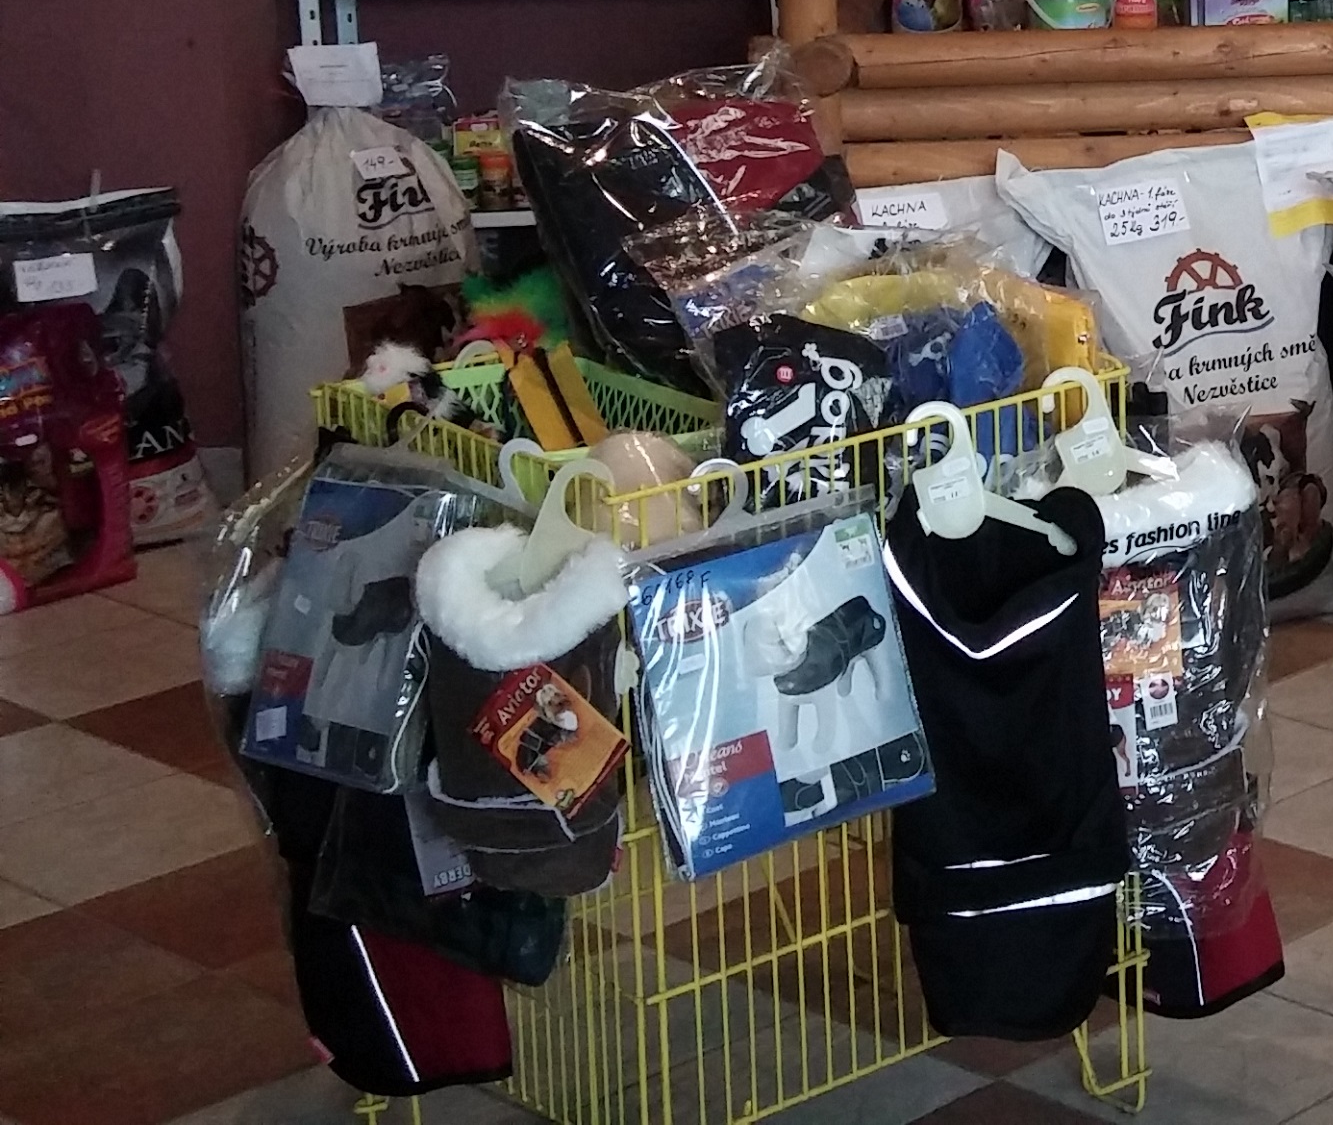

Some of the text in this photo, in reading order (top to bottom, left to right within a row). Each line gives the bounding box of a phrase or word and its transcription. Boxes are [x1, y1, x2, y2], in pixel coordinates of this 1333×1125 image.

[871, 200, 927, 218] KACHNA
[305, 234, 382, 262] Výroba
[1152, 281, 1271, 350] Fink
[1188, 345, 1275, 380] krmných
[1183, 372, 1279, 406] Nezvěstice
[1124, 520, 1201, 556] fashion
[1207, 507, 1242, 532] line
[497, 668, 542, 725] Aviator
